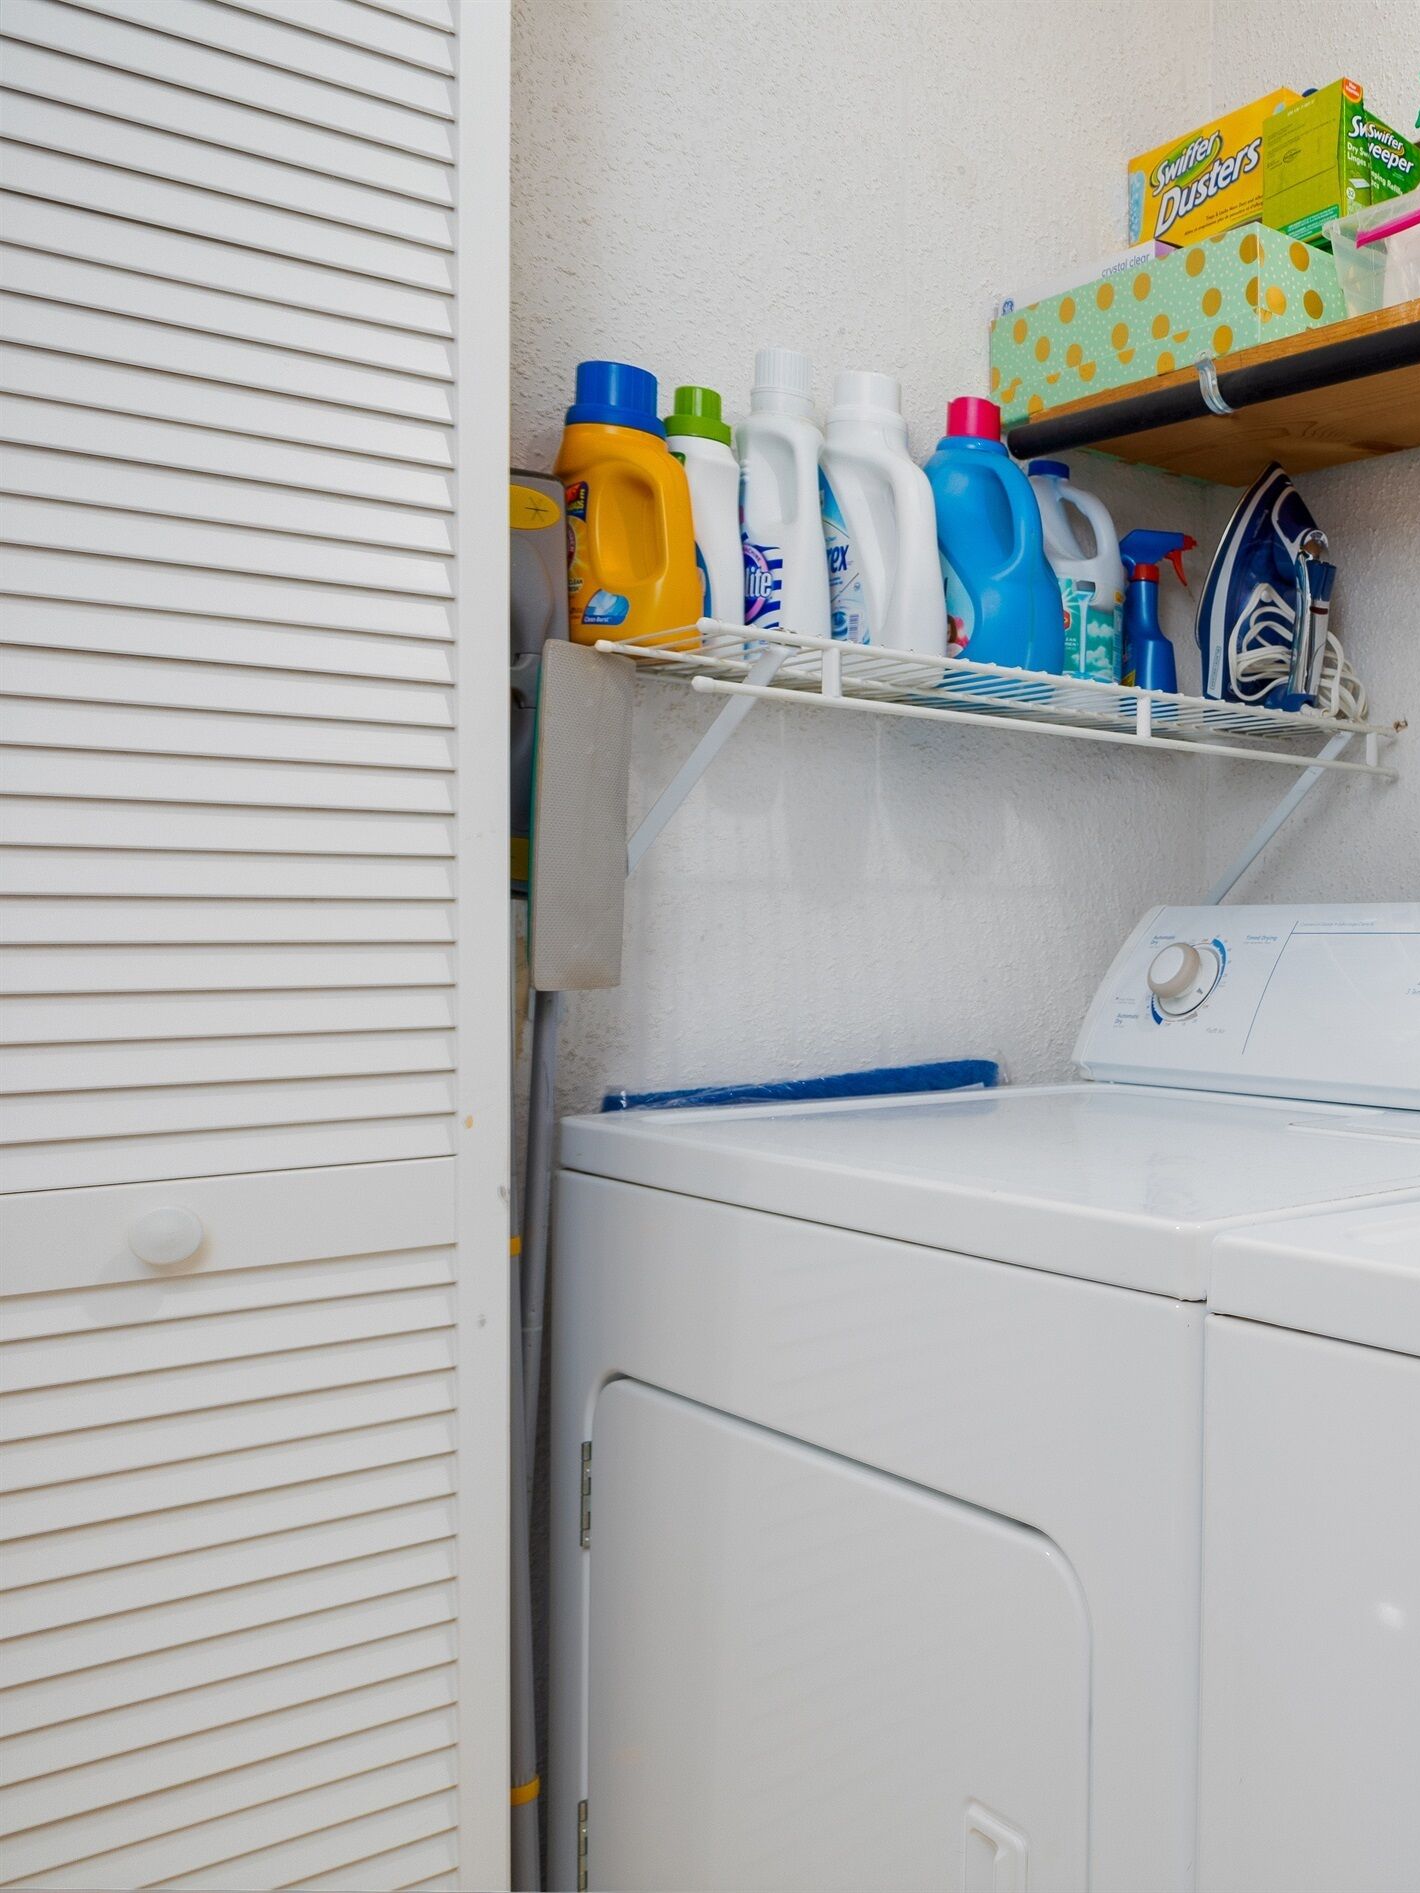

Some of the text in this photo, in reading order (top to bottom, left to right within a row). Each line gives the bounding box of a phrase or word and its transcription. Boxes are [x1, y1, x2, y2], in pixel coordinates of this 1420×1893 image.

[1366, 124, 1404, 150] Swiffer
[1152, 130, 1220, 197] Swiffer
[1153, 137, 1263, 239] Dusters
[1101, 252, 1150, 279] crystal clear
